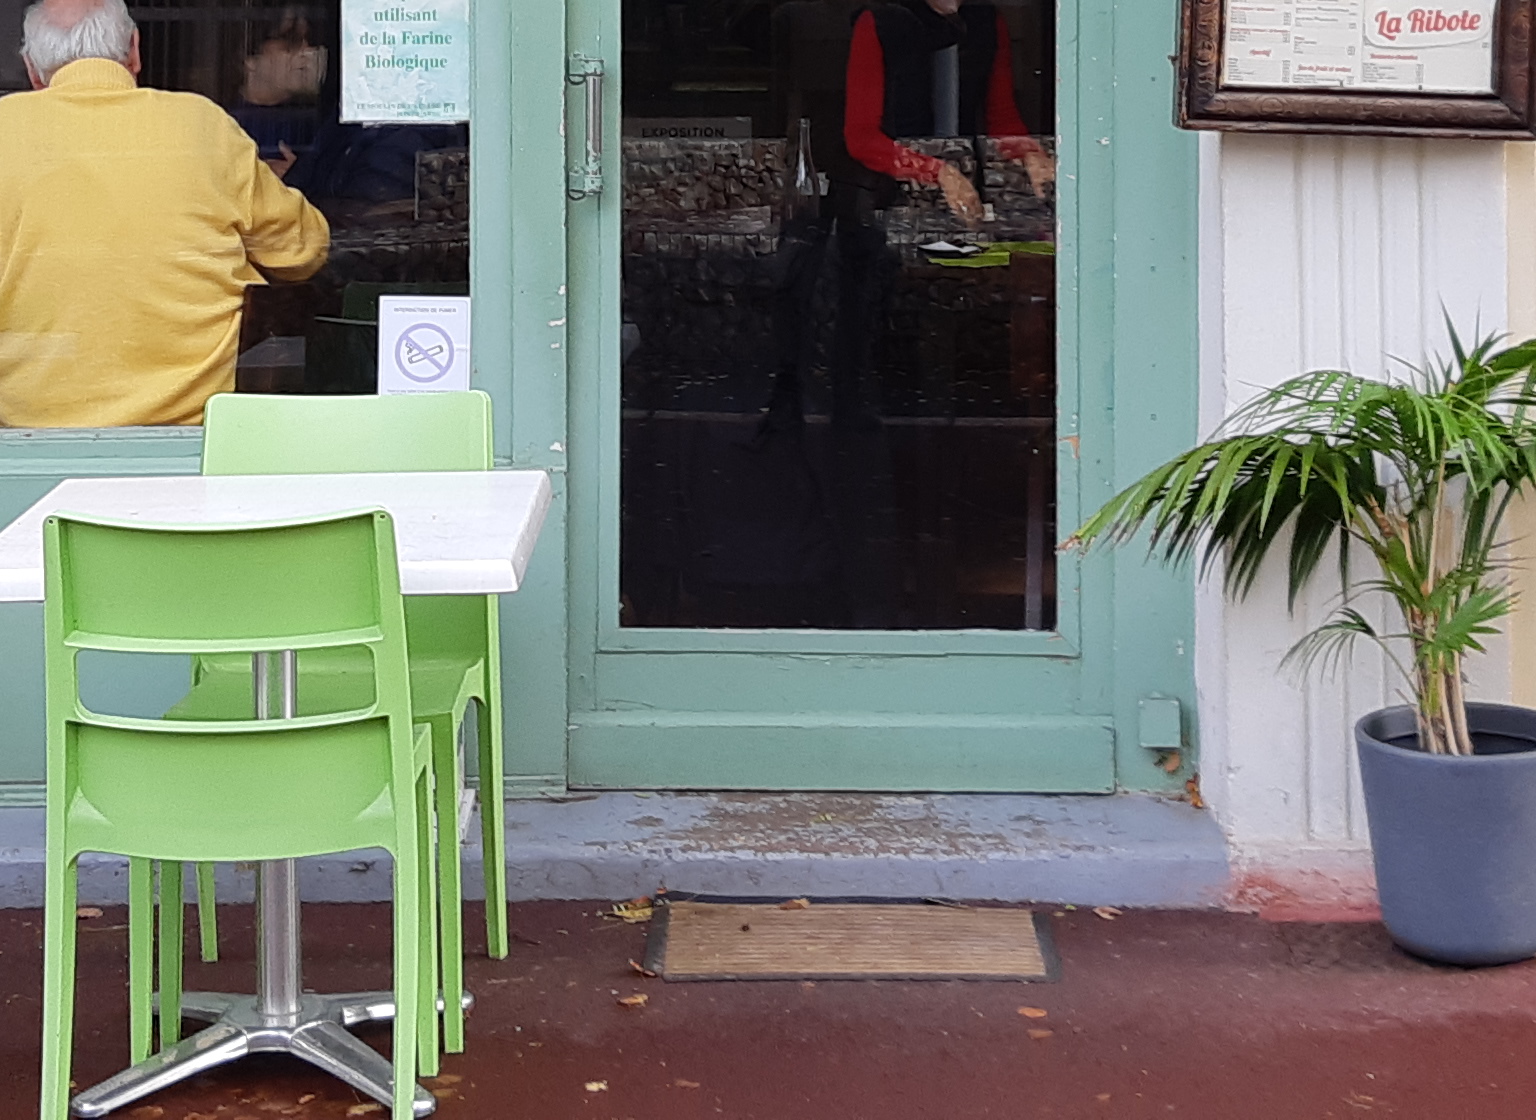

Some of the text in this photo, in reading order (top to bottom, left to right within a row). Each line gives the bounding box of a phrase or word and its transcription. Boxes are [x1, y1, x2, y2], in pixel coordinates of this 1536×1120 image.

[374, 7, 438, 22] utilisant
[1375, 10, 1402, 40] La
[1407, 8, 1482, 33] Ribote
[359, 31, 453, 45] de la Farine
[365, 54, 448, 71] Biologique
[641, 126, 725, 138] EXPOSITION
